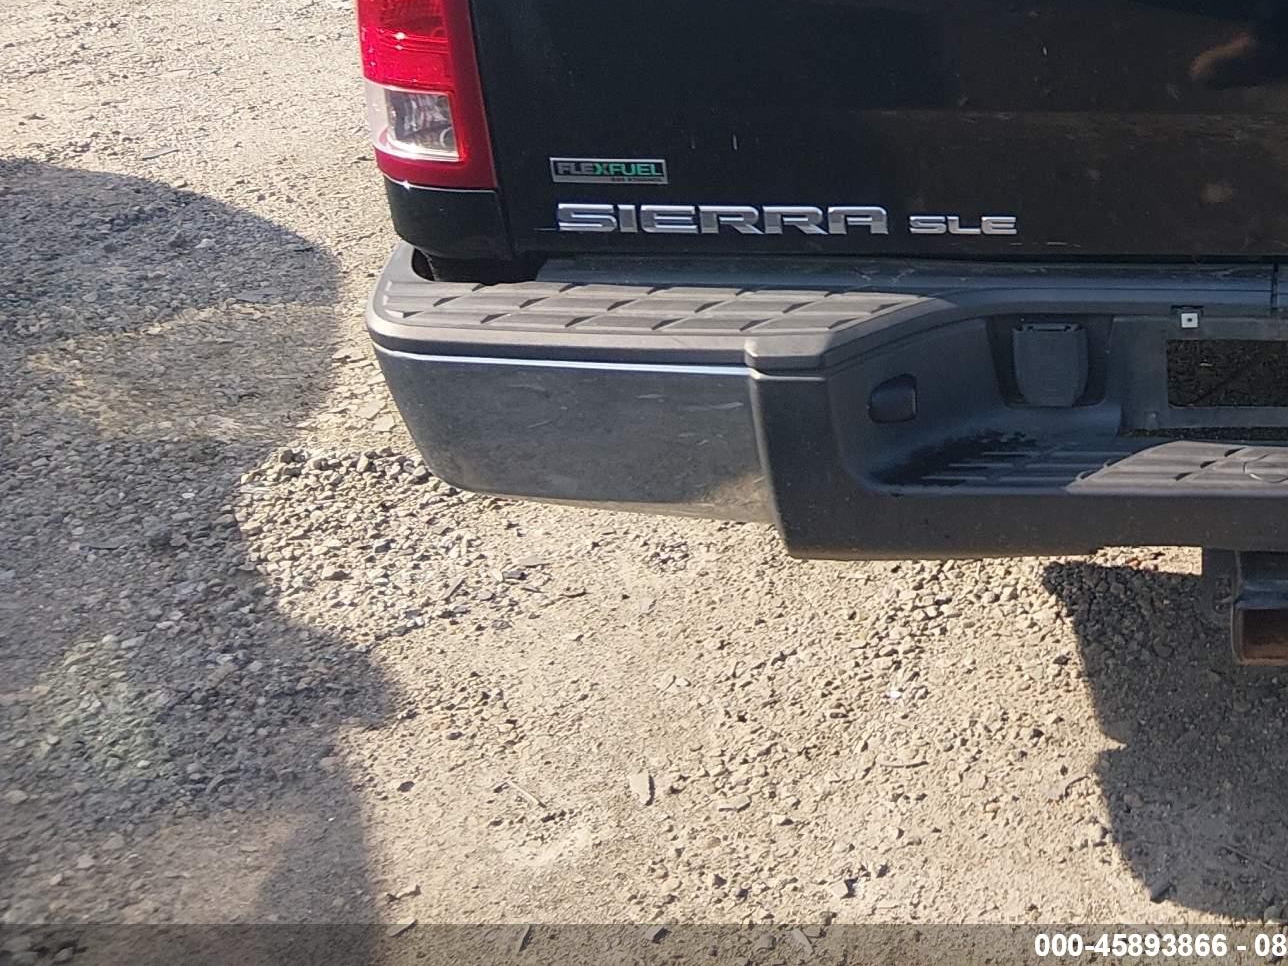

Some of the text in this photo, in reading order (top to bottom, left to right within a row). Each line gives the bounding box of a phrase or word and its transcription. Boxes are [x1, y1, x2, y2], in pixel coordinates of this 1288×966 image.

[556, 162, 664, 176] FLEXFUEL
[556, 202, 1018, 236] SIERRA SLE
